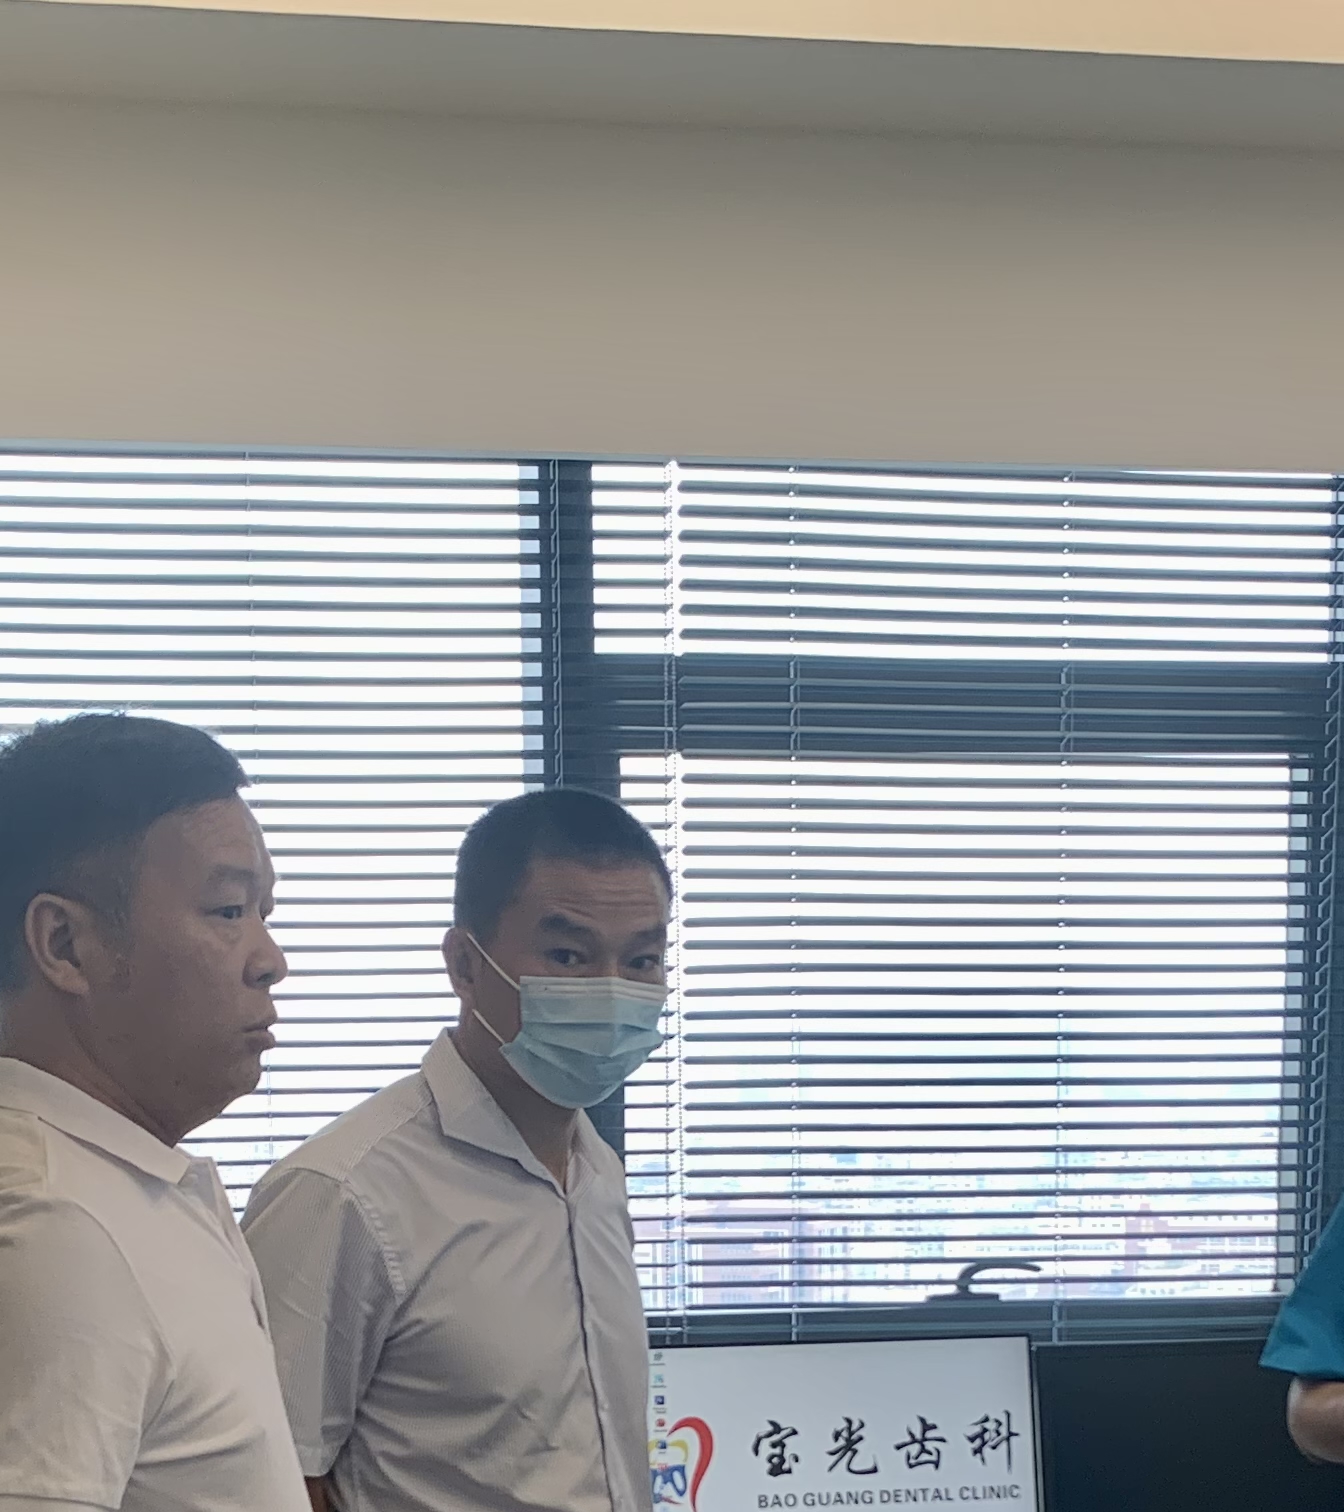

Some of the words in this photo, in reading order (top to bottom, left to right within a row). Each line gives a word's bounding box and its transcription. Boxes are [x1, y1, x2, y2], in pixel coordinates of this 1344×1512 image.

[751, 1409, 1020, 1477] 宝光齿科
[757, 1492, 797, 1509] BAO
[802, 1488, 874, 1507] GUANG
[880, 1486, 954, 1504] DENTAL
[959, 1483, 1020, 1500] CLINIC
